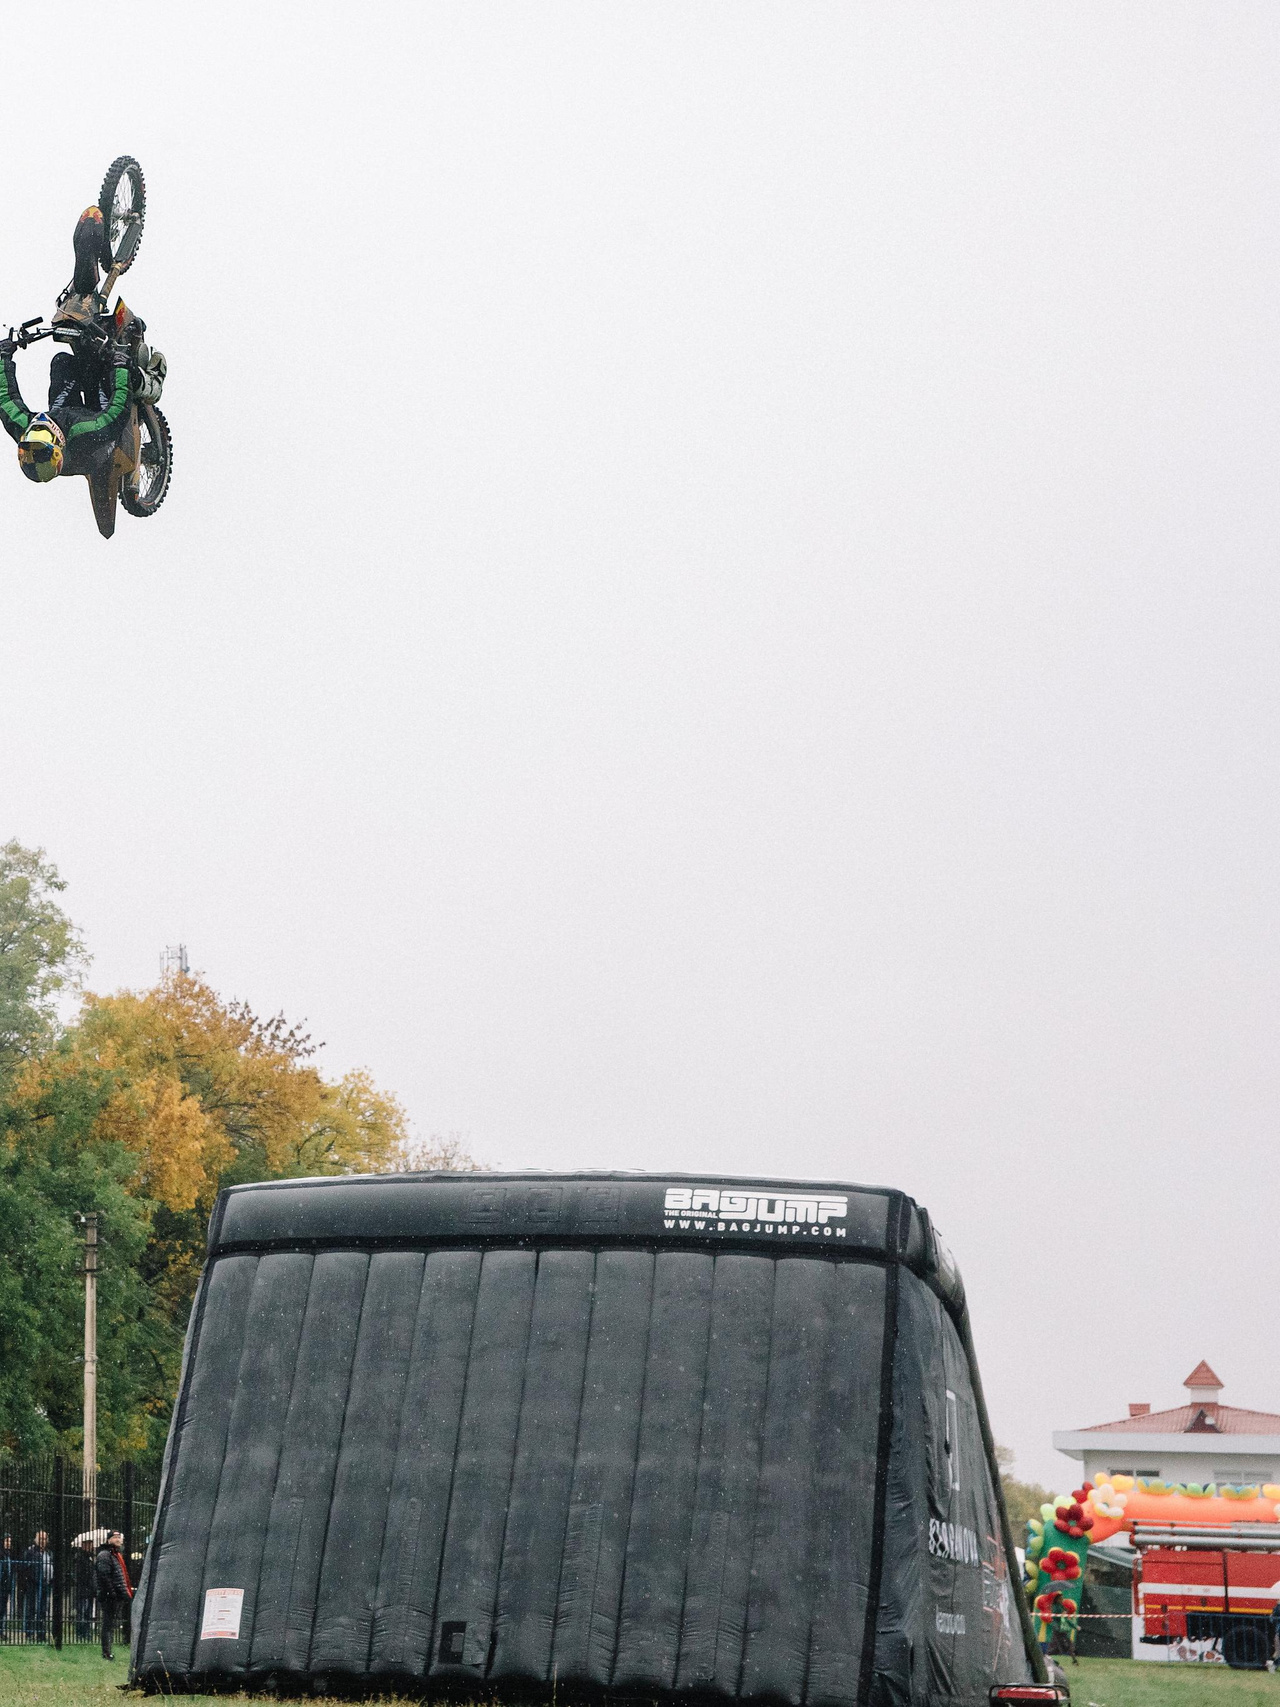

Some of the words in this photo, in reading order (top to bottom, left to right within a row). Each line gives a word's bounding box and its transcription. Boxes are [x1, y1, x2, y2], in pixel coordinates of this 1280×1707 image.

[665, 1188, 848, 1224] BAGJUMP
[681, 1210, 718, 1219] ORIGINAL
[664, 1220, 846, 1237] WWW.BAGJUMP.COM
